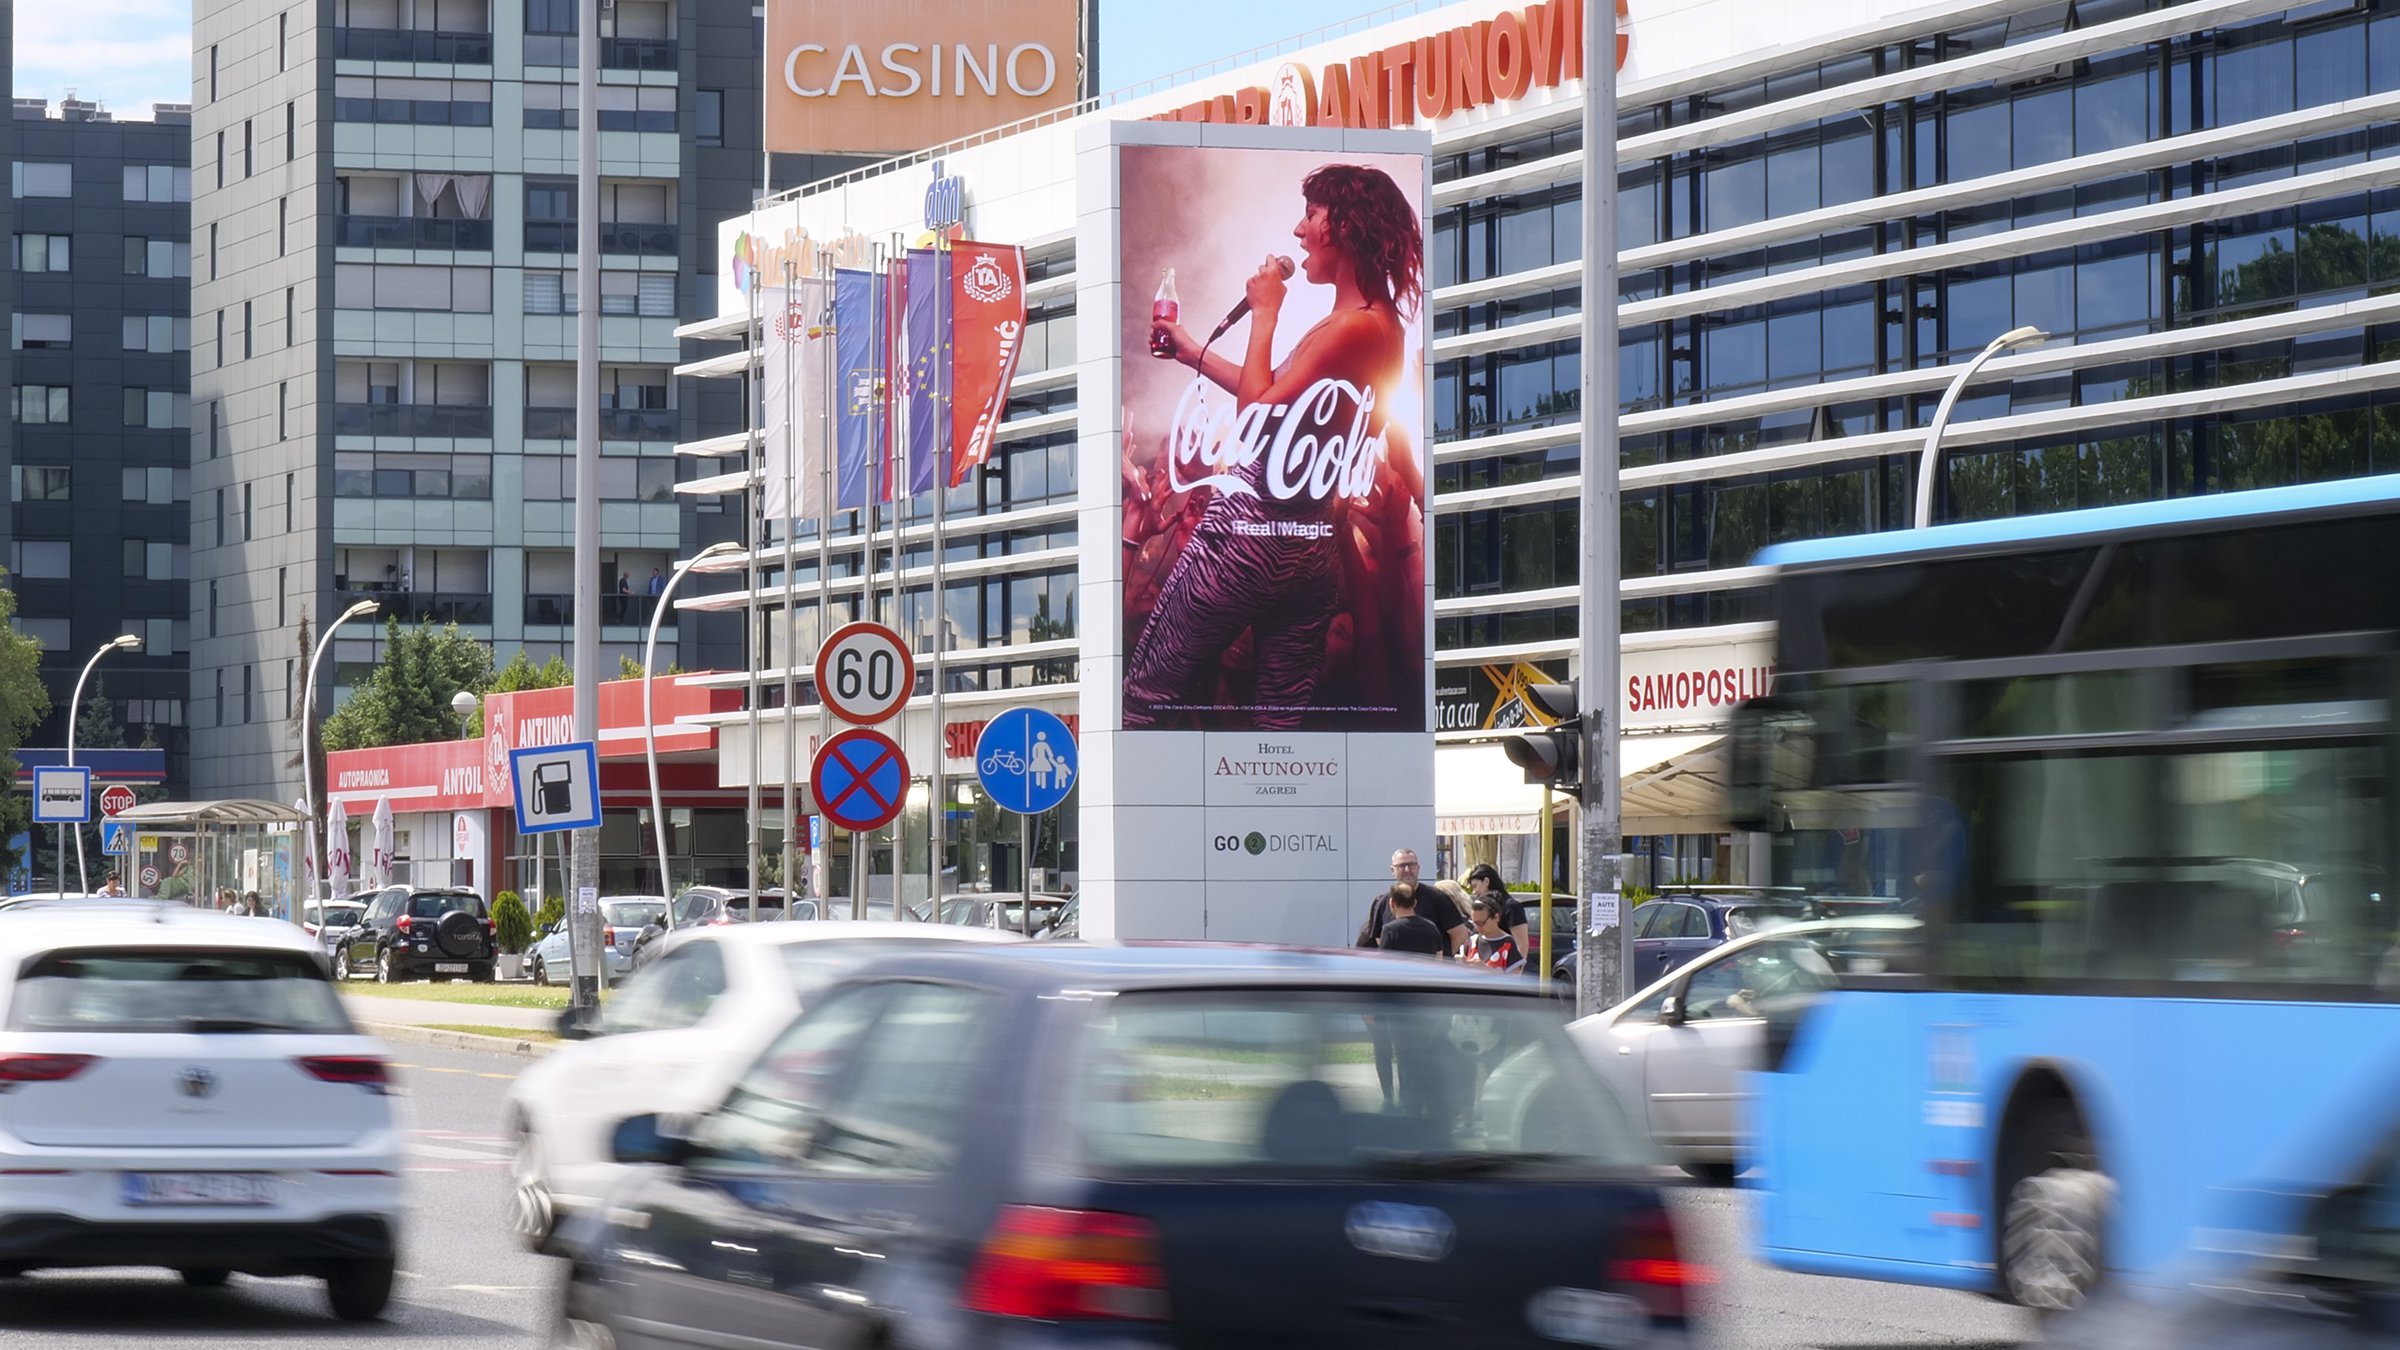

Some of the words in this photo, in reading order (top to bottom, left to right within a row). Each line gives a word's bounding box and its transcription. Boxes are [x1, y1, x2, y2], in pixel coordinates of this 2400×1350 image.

[784, 43, 1057, 98] CASINO
[924, 160, 960, 230] dm
[1169, 374, 1390, 500] Coca-Cola
[1232, 520, 1276, 536] Real
[1279, 520, 1333, 539] Magic
[837, 648, 894, 701] 60
[1446, 704, 1455, 728] a
[1458, 702, 1479, 728] car
[338, 768, 390, 788] AUTOPRAONICA
[443, 766, 484, 796] ANTOIL
[1255, 786, 1297, 795] ZAGREB
[104, 796, 132, 809] STOP
[1214, 835, 1240, 851] GO
[1270, 834, 1338, 852] DIGITAL
[173, 848, 185, 858] 70
[143, 869, 156, 883] 50
[453, 933, 481, 942] TOYOTA
